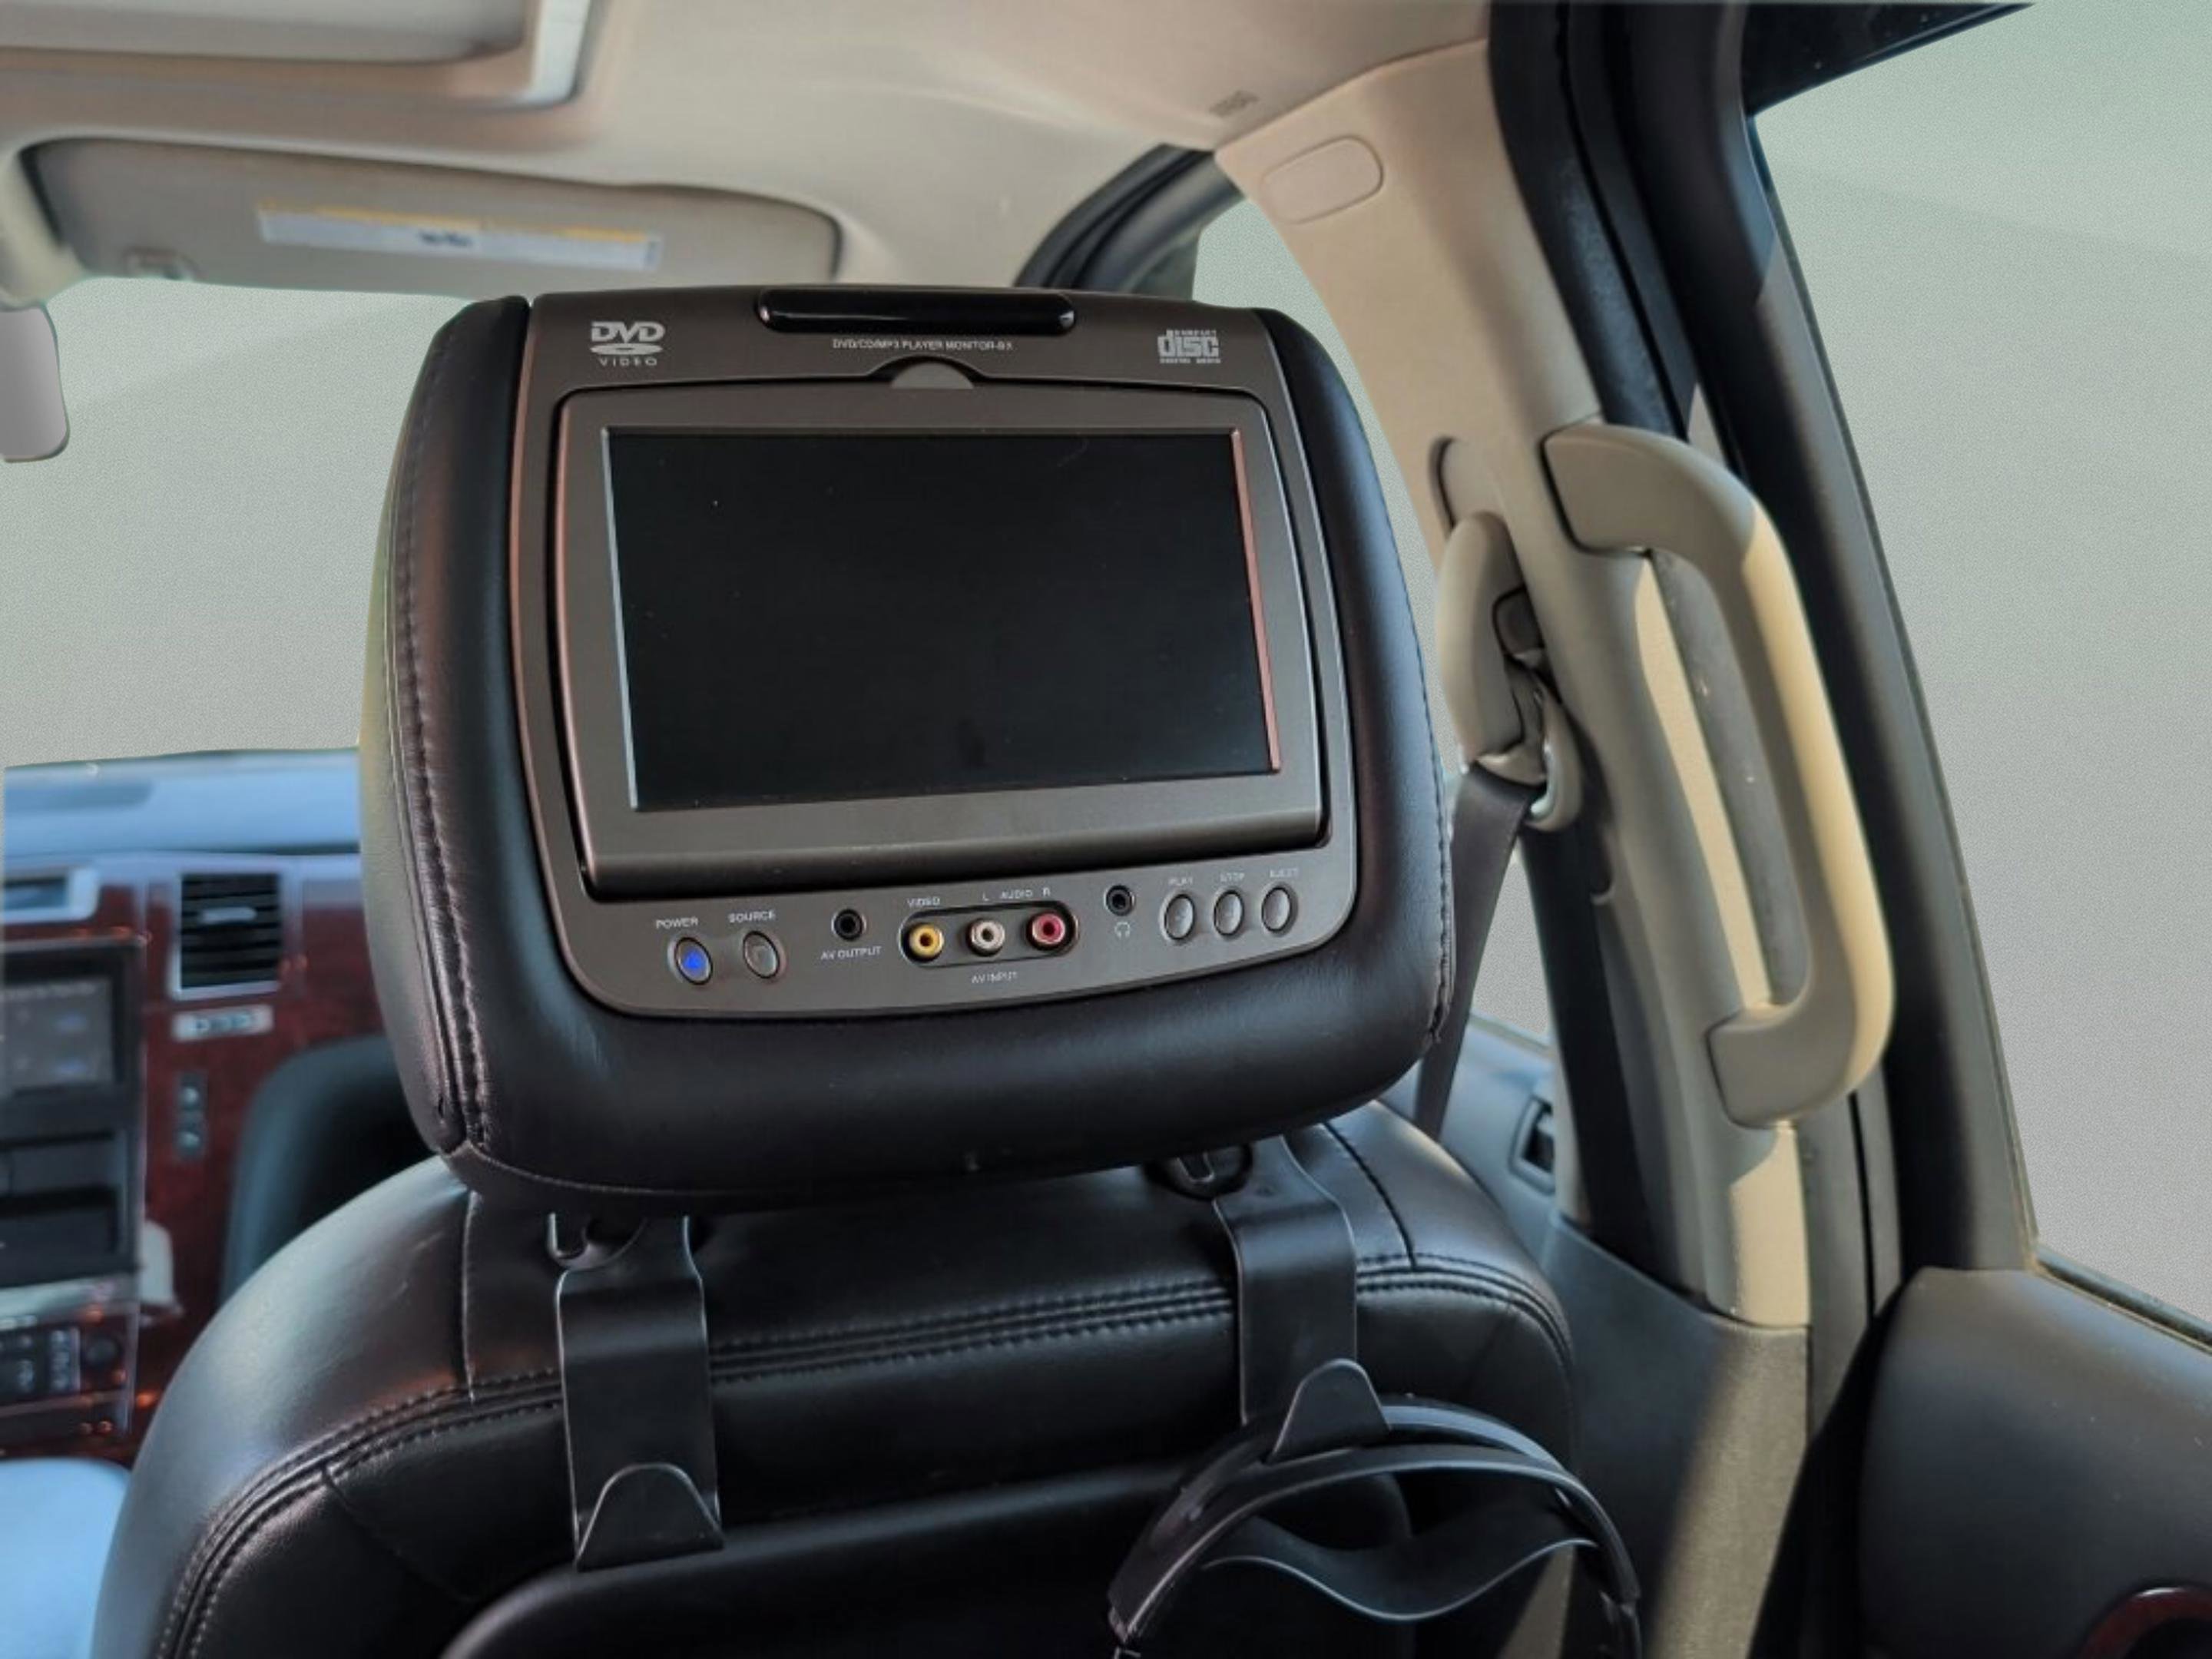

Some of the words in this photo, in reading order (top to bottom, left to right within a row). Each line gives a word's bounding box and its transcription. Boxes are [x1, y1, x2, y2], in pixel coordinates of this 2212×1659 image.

[591, 321, 665, 343] DVD
[598, 357, 657, 367] VIDEO
[907, 896, 941, 907] VIDEO
[982, 893, 989, 902] L
[1000, 889, 1033, 900] AUDIO
[656, 916, 699, 929] POWER
[728, 910, 776, 923] SOURCE
[820, 949, 836, 960] AV
[837, 945, 882, 959] OUTPUT
[987, 971, 1018, 982] INPUT
